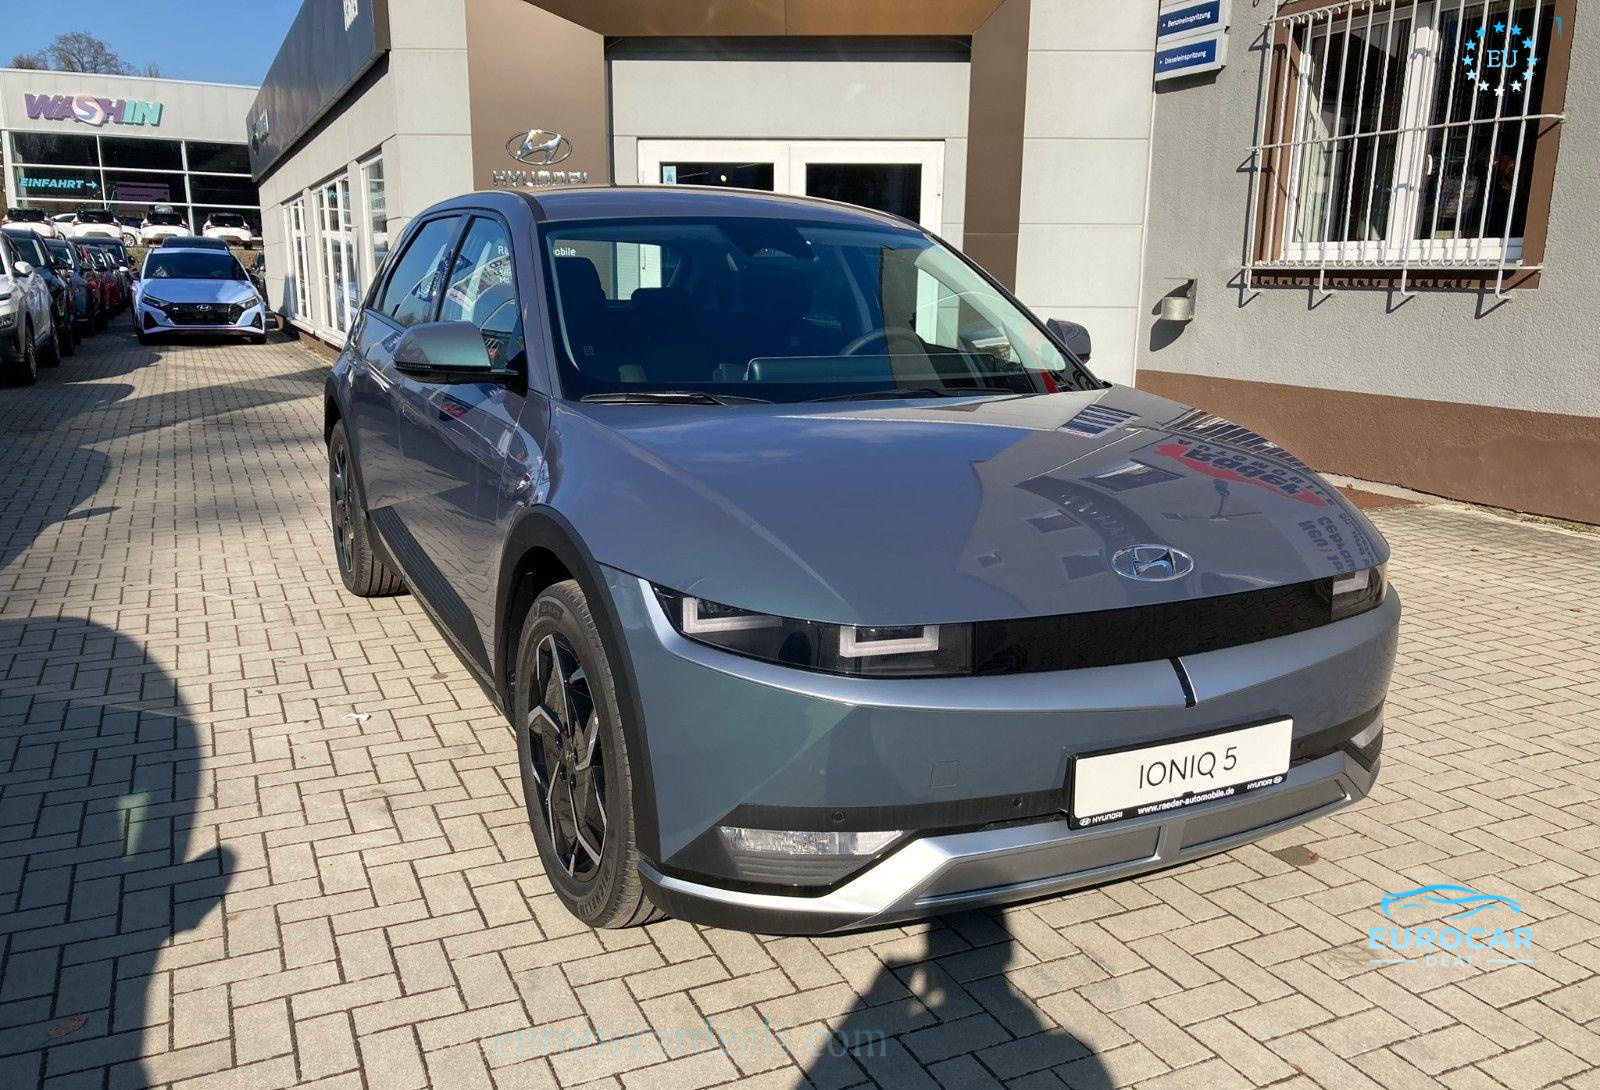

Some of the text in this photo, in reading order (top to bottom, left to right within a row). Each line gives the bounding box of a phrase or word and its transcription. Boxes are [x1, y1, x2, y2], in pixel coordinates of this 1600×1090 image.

[1167, 11, 1211, 28] Benzineinspritzung
[1164, 50, 1207, 65] Dieseleinspritzung
[20, 177, 84, 189] EINFAHRT
[492, 170, 588, 188] HYUNDAI
[1139, 746, 1238, 789] IONIQ 5
[1246, 779, 1273, 790] HYUNDAI
[1137, 786, 1235, 815] www.raeder-automobile.de
[1092, 811, 1123, 824] HYUNDAI
